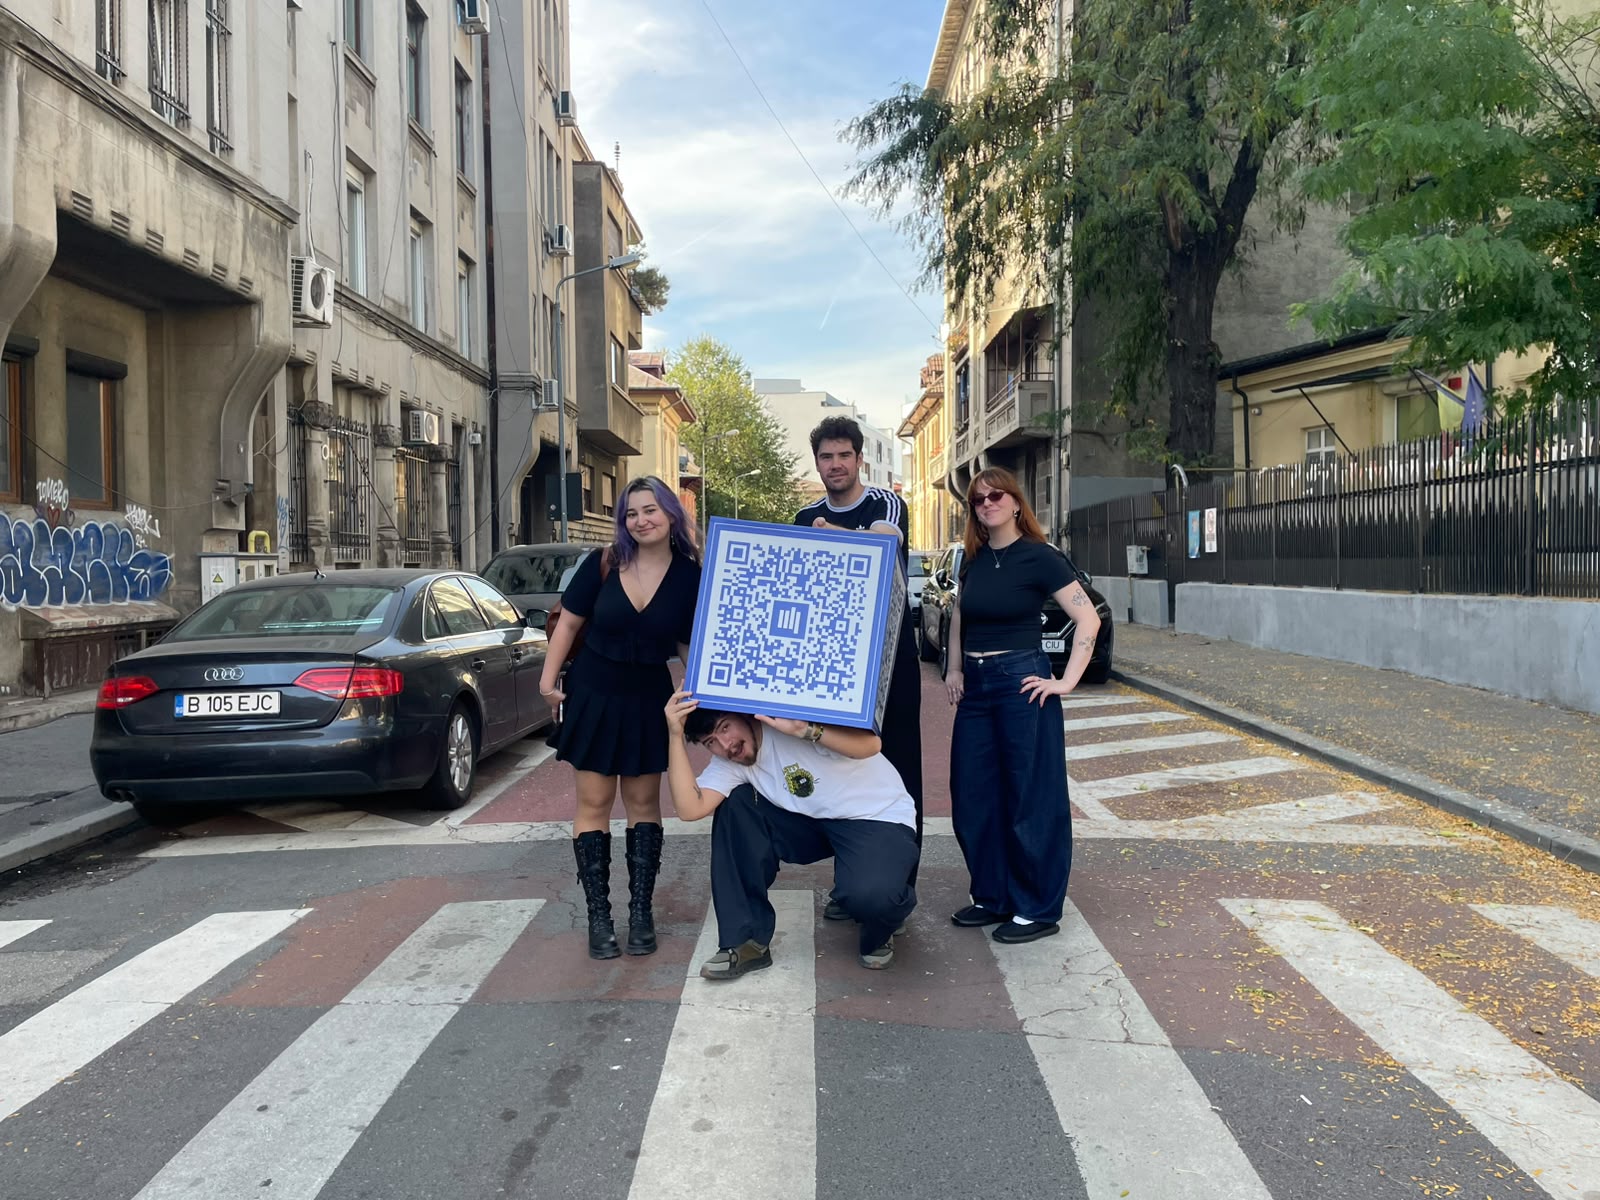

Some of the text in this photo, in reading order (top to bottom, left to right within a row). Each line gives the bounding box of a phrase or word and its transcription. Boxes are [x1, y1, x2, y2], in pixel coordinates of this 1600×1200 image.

[1045, 640, 1060, 649] CIU
[188, 696, 200, 713] B
[207, 695, 233, 713] 105
[238, 694, 273, 712] EJC
